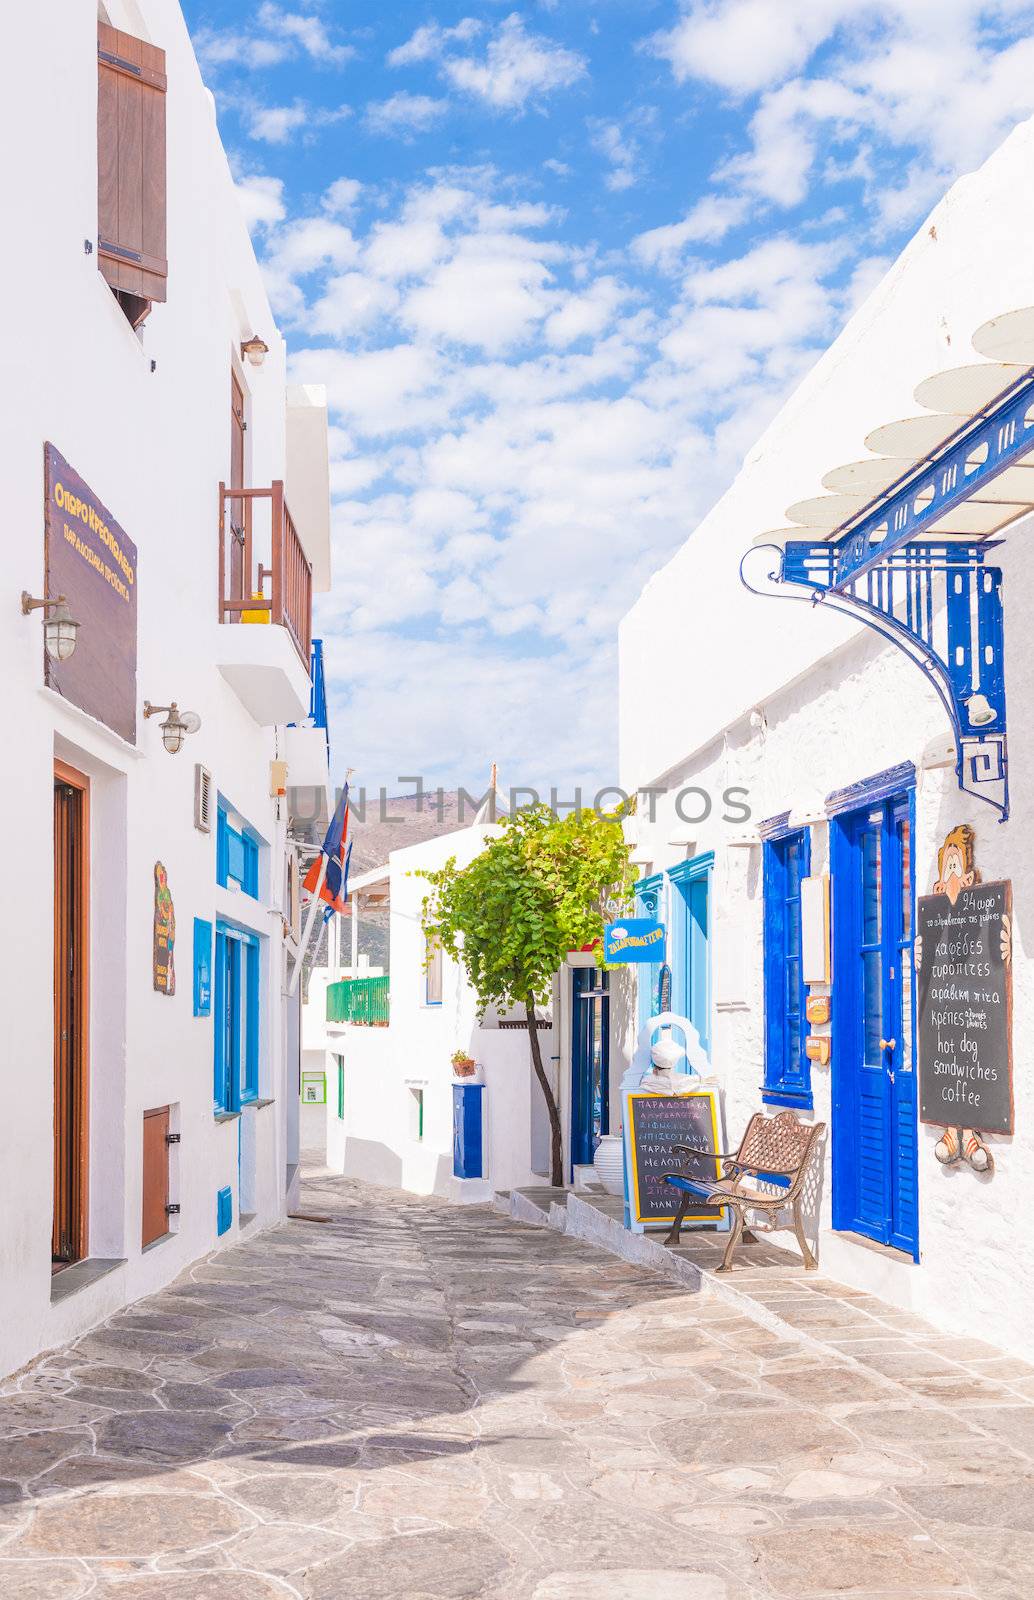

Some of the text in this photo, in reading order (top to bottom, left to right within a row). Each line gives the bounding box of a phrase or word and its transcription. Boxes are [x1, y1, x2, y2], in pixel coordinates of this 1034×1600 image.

[937, 1031, 979, 1063] hot dog
[933, 1056, 998, 1081] sandwiches
[942, 1079, 981, 1107] coffee
